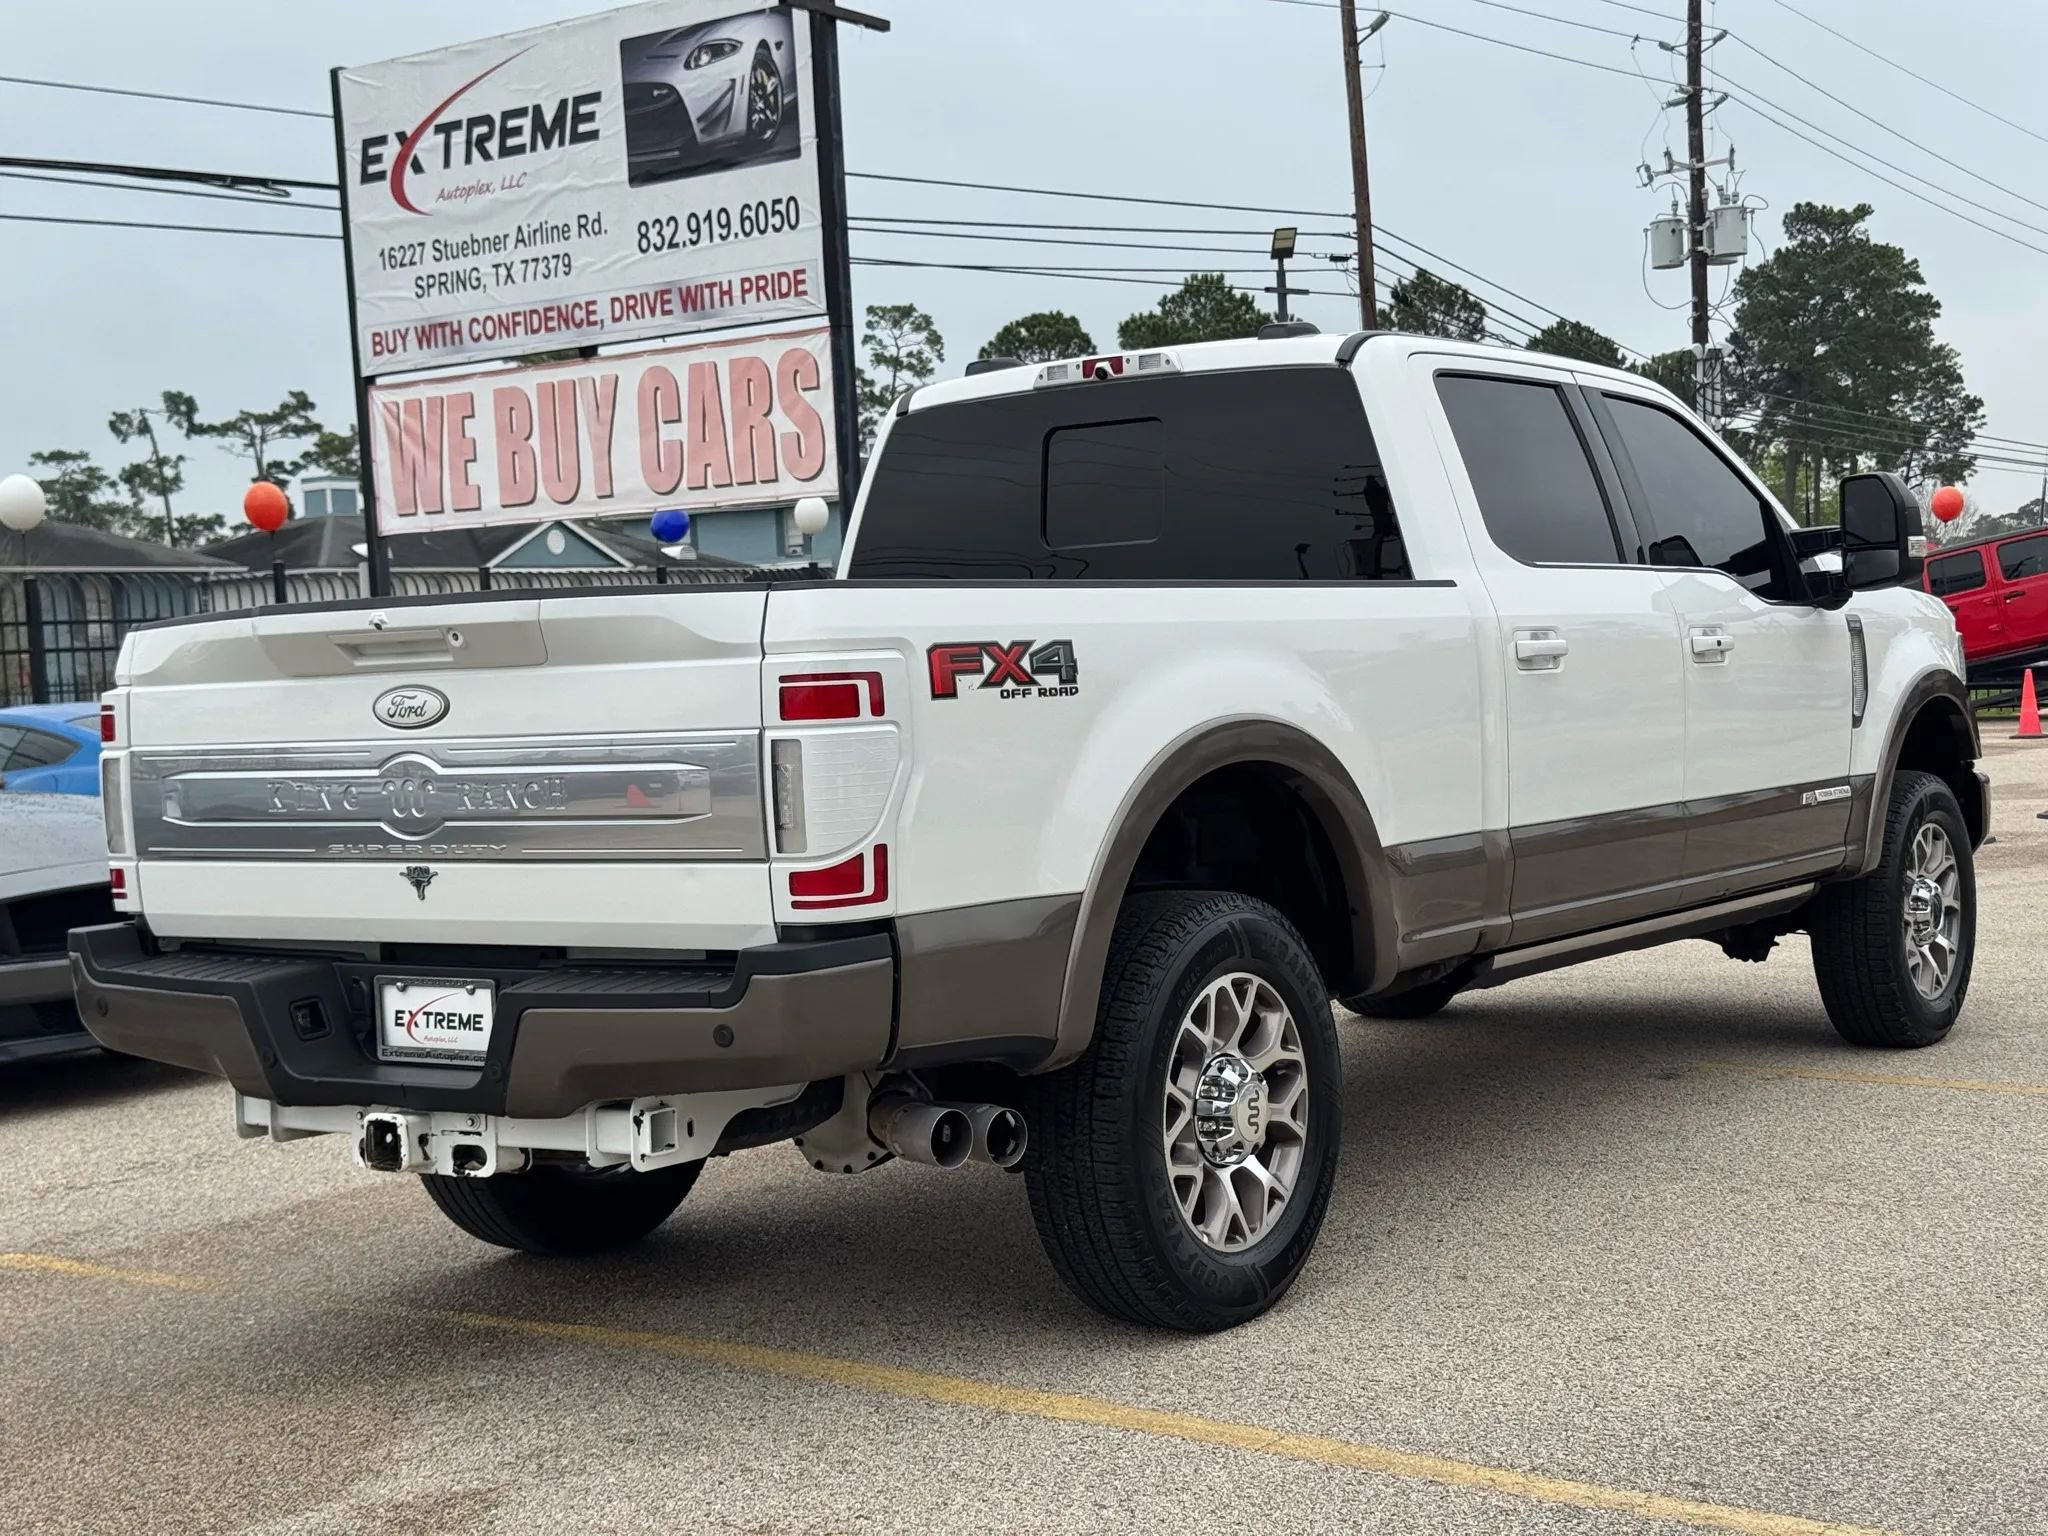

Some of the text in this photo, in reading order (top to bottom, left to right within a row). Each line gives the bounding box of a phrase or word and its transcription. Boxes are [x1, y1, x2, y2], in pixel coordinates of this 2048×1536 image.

[360, 91, 602, 186] EXTREME
[434, 172, 527, 204] Autoplex, LLC
[378, 212, 608, 271] 16227 Stuebner Airline Rd.
[636, 195, 801, 255] 832.919.6050
[414, 252, 572, 299] SPRING, TX 77379
[371, 268, 809, 358] BUY WITH CONFIDENCE, DRIVE WITH PRIDE
[382, 347, 826, 517] WE BUY CARS
[926, 639, 1079, 701] FX4
[387, 694, 428, 719] Ford
[1000, 686, 1079, 699] OFF ROAD
[267, 777, 568, 812] KING RANCH
[328, 843, 508, 855] SUPER DUTY
[394, 1009, 484, 1032] EXTREME
[382, 1049, 486, 1062] ExtremeAutoplex.co
